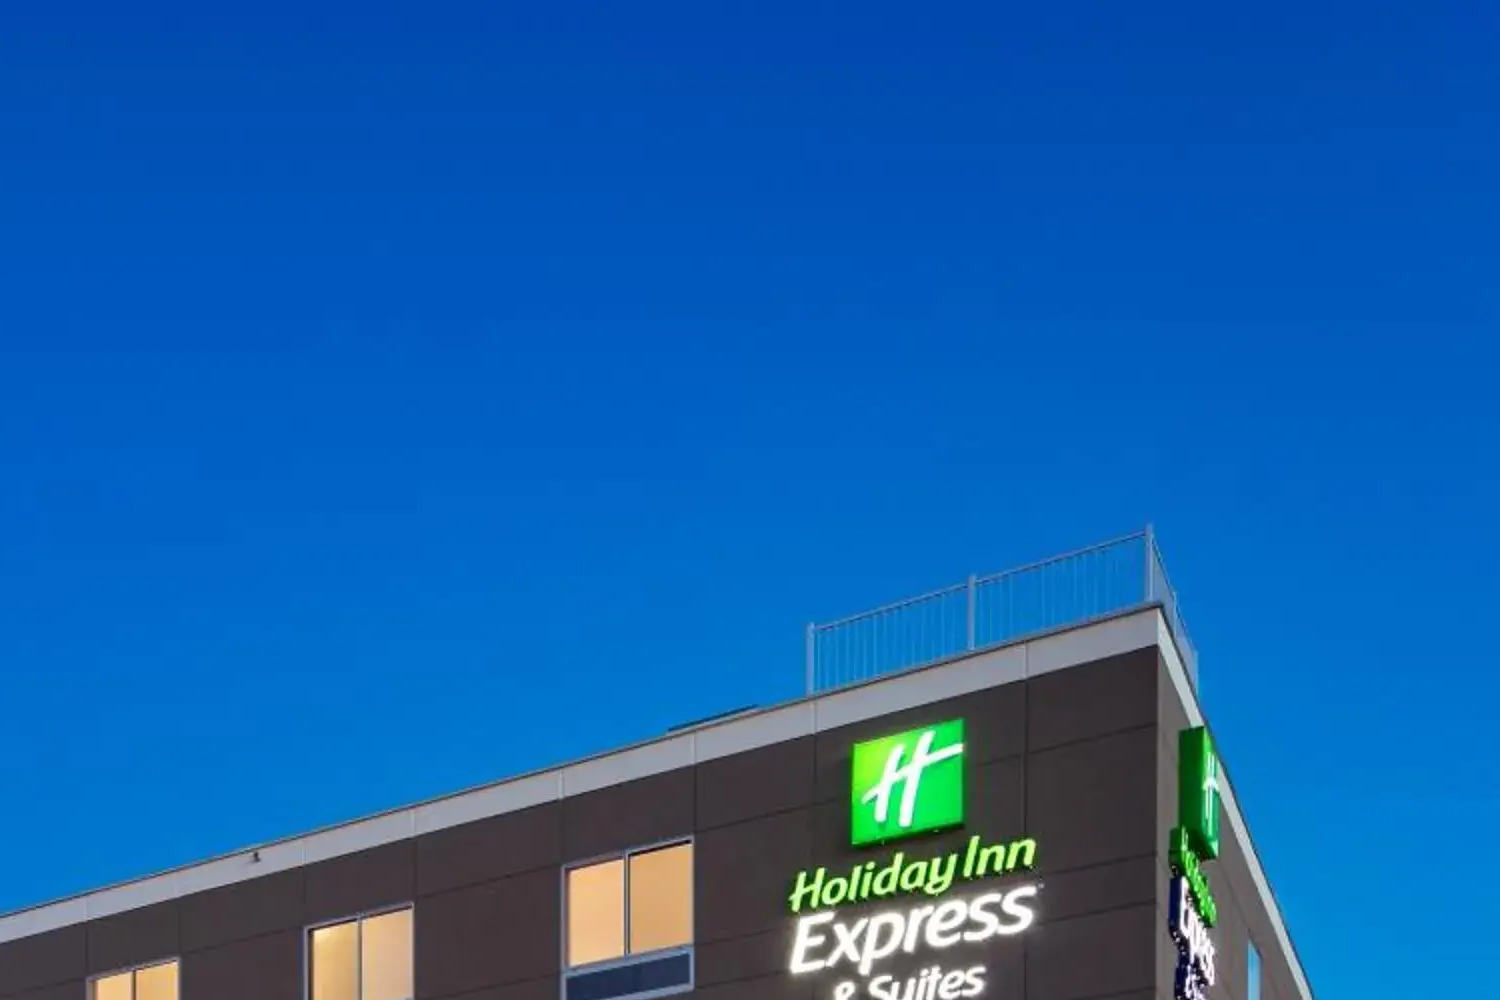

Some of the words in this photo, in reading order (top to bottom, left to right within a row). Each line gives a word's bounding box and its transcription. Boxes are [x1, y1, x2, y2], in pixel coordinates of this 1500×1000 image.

[861, 731, 964, 827] H
[789, 852, 958, 912] Holiday
[963, 835, 1037, 878] Inn
[789, 885, 1038, 976] Express
